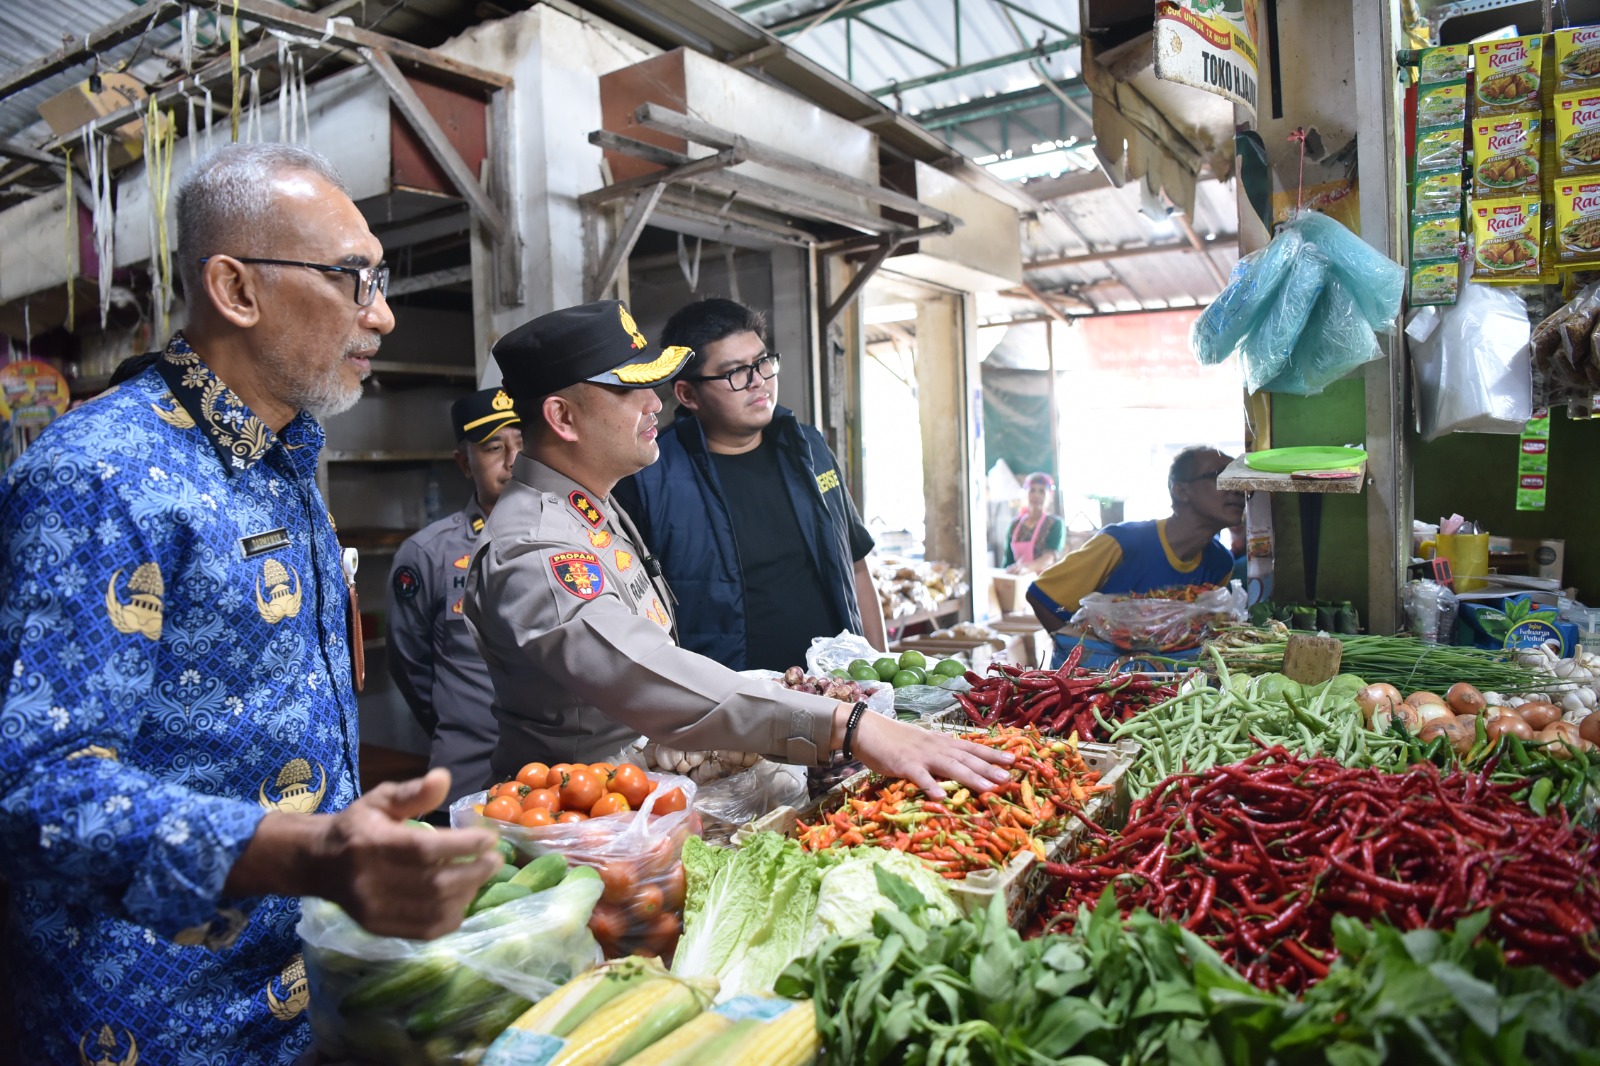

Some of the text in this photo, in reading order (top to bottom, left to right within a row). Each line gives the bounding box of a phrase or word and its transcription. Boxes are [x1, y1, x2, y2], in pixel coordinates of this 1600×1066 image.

[1158, 5, 1182, 18] OCOK
[1184, 13, 1205, 33] UNTUK
[1206, 27, 1213, 39] 1X
[1489, 47, 1528, 68] Racik
[1202, 51, 1232, 92] TOKO
[1488, 130, 1527, 150] Racik
[1487, 213, 1526, 232] Racik
[553, 553, 595, 562] PROPAM
